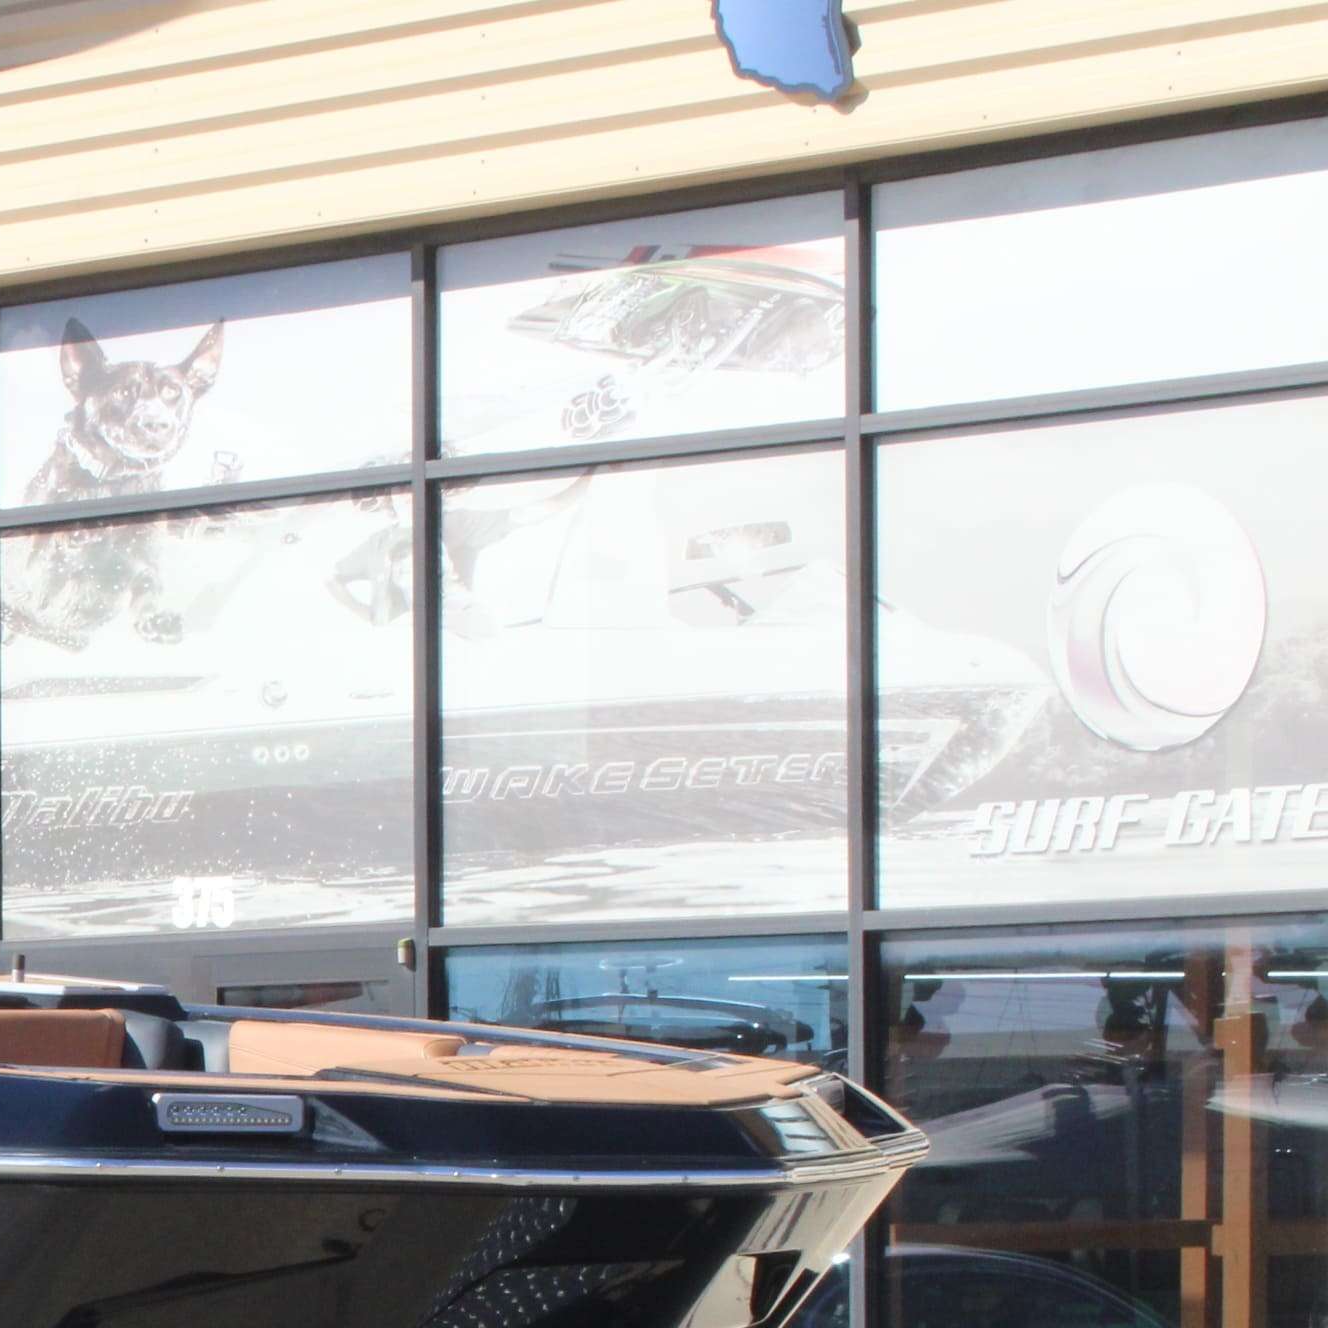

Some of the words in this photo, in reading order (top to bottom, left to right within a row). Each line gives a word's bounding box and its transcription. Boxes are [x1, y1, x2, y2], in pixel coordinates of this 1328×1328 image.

[971, 793, 1150, 858] SURF
[1165, 784, 1328, 848] GATE
[172, 876, 234, 928] 375
